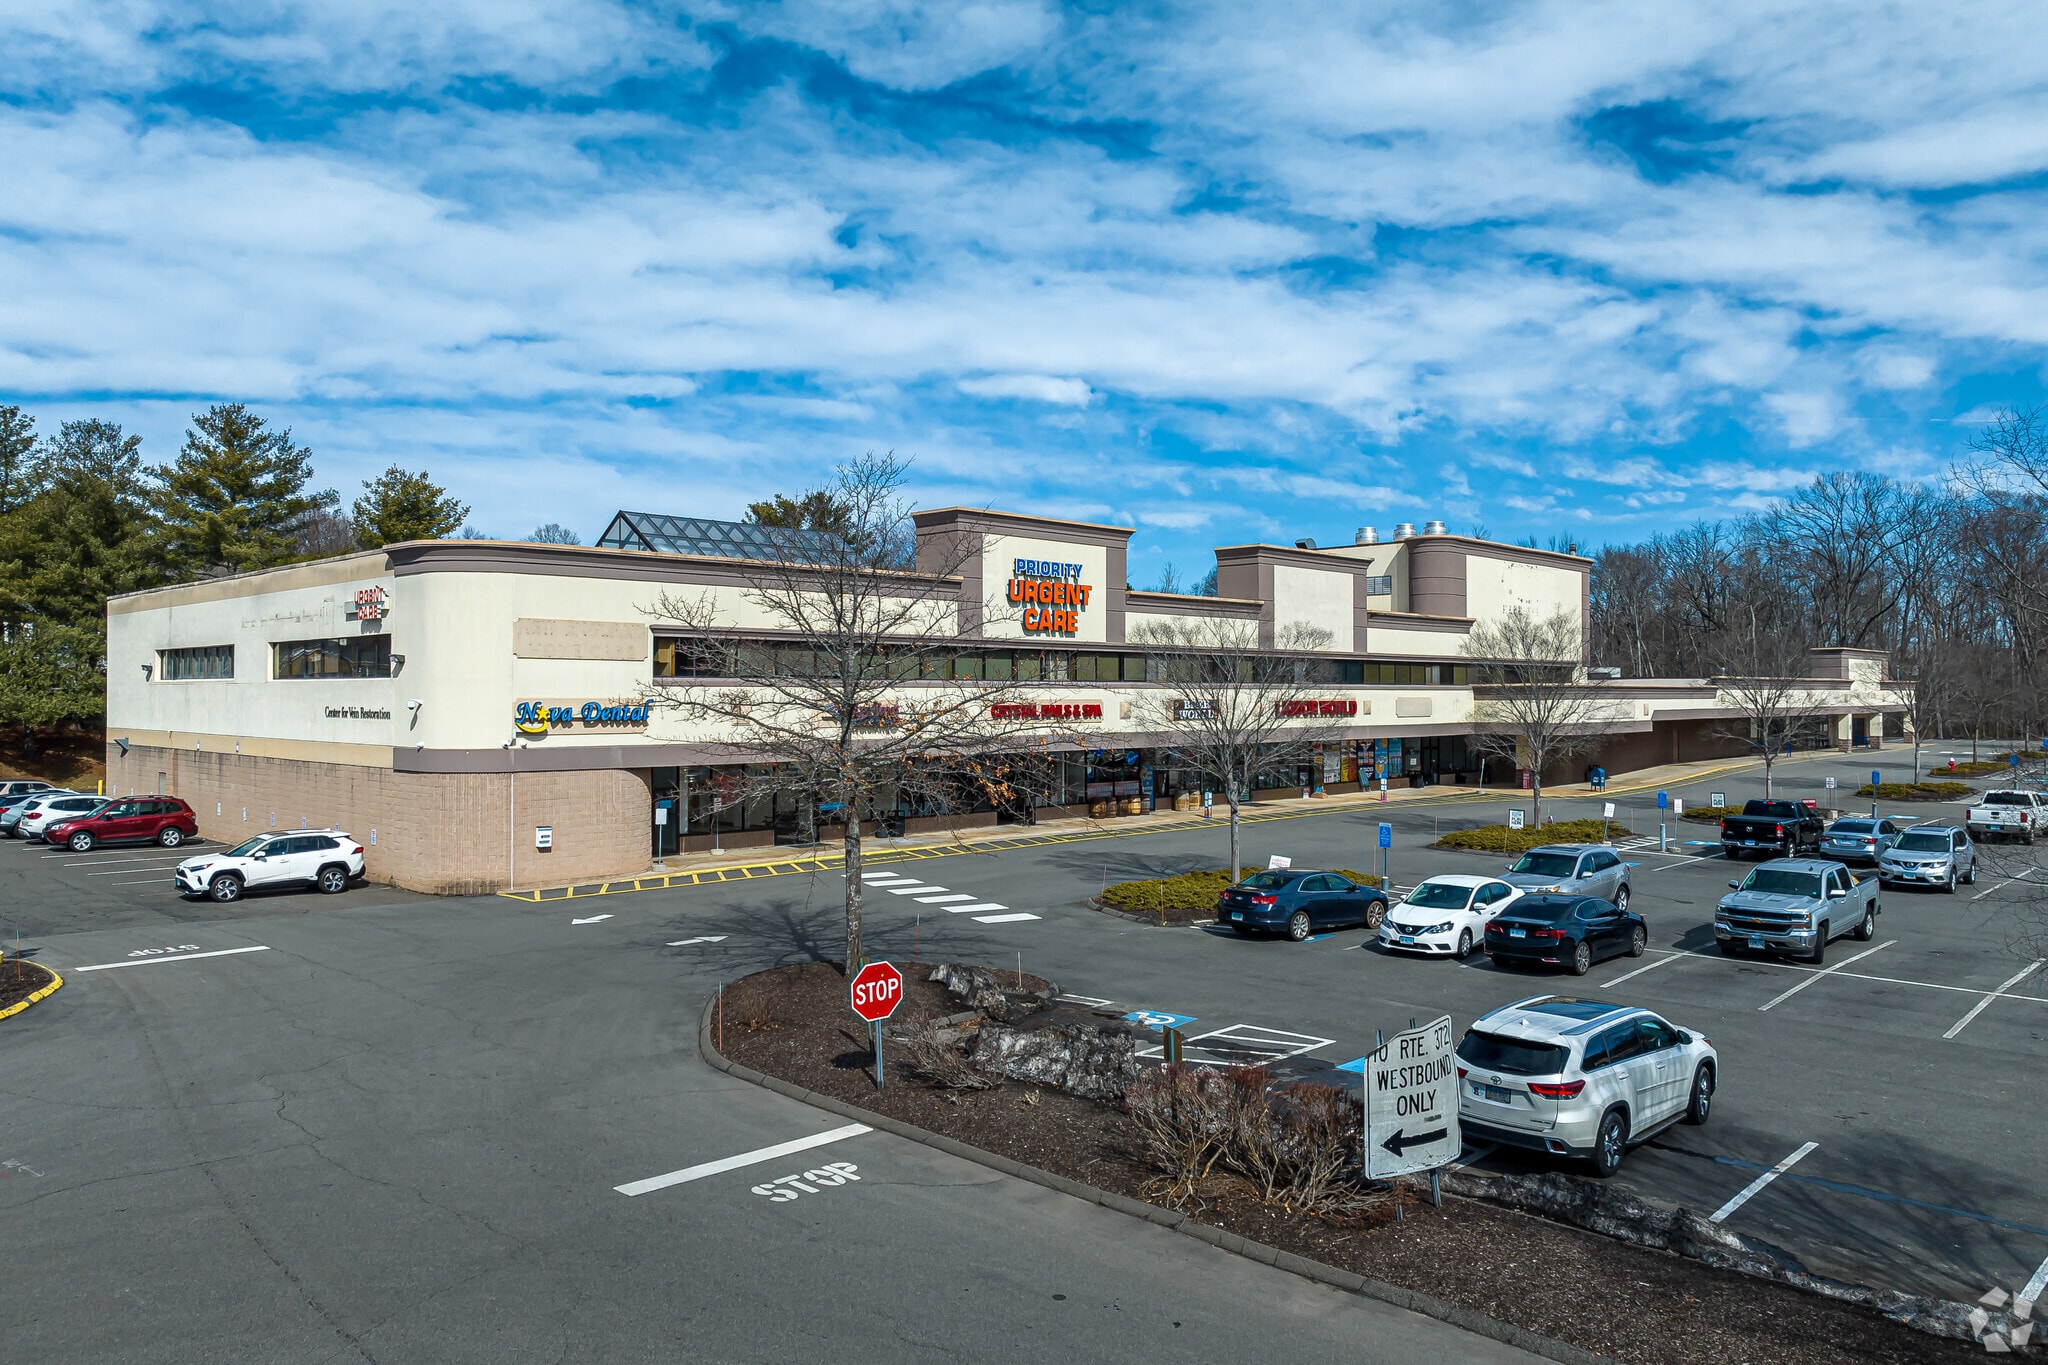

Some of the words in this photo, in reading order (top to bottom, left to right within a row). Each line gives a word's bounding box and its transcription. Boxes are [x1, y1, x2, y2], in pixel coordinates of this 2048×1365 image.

[1015, 558, 1083, 578] PRIORITY
[354, 588, 383, 604] URGENT
[1008, 579, 1092, 606] URGENT
[358, 605, 380, 620] CARE
[1023, 608, 1078, 632] CARE
[325, 706, 340, 718] Center
[349, 706, 359, 718] Vein
[360, 706, 390, 720] Restoration
[581, 699, 655, 722] Dental
[1073, 704, 1081, 718] &
[1082, 704, 1102, 718] SPA
[1319, 700, 1358, 716] WORLD
[855, 977, 899, 1005] STOP
[1400, 1036, 1428, 1060] RTE.
[1434, 1024, 1449, 1050] 372
[1377, 1054, 1452, 1091] WESTBOUND
[1397, 1089, 1437, 1116] ONLY
[751, 1162, 861, 1202] STOP
